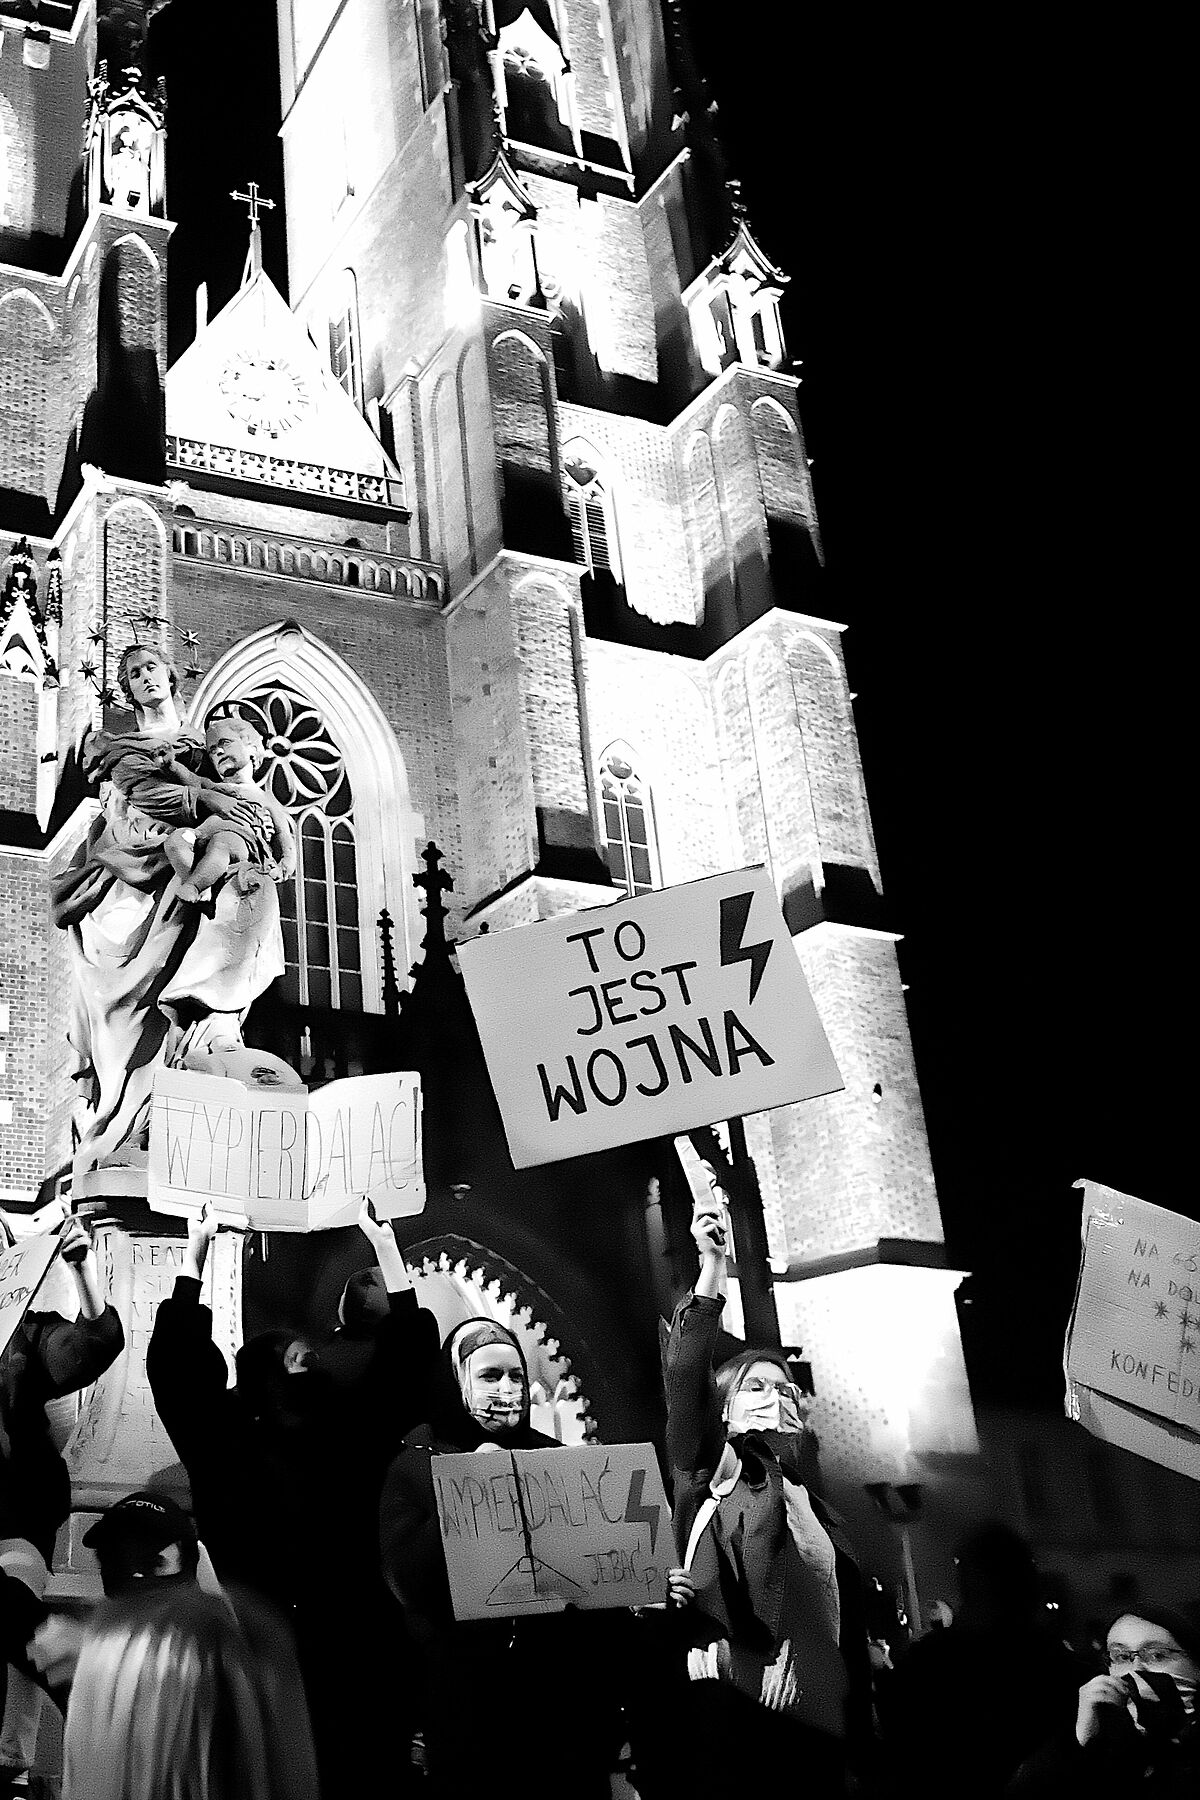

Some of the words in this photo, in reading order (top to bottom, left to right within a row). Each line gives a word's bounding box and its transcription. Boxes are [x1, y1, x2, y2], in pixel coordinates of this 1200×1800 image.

[565, 919, 646, 974] TO
[567, 960, 698, 1036] JEST
[536, 1009, 776, 1123] WOJNA
[1133, 1238, 1159, 1258] NA
[1127, 1269, 1151, 1289] NA
[1111, 1349, 1200, 1397] KONFED
